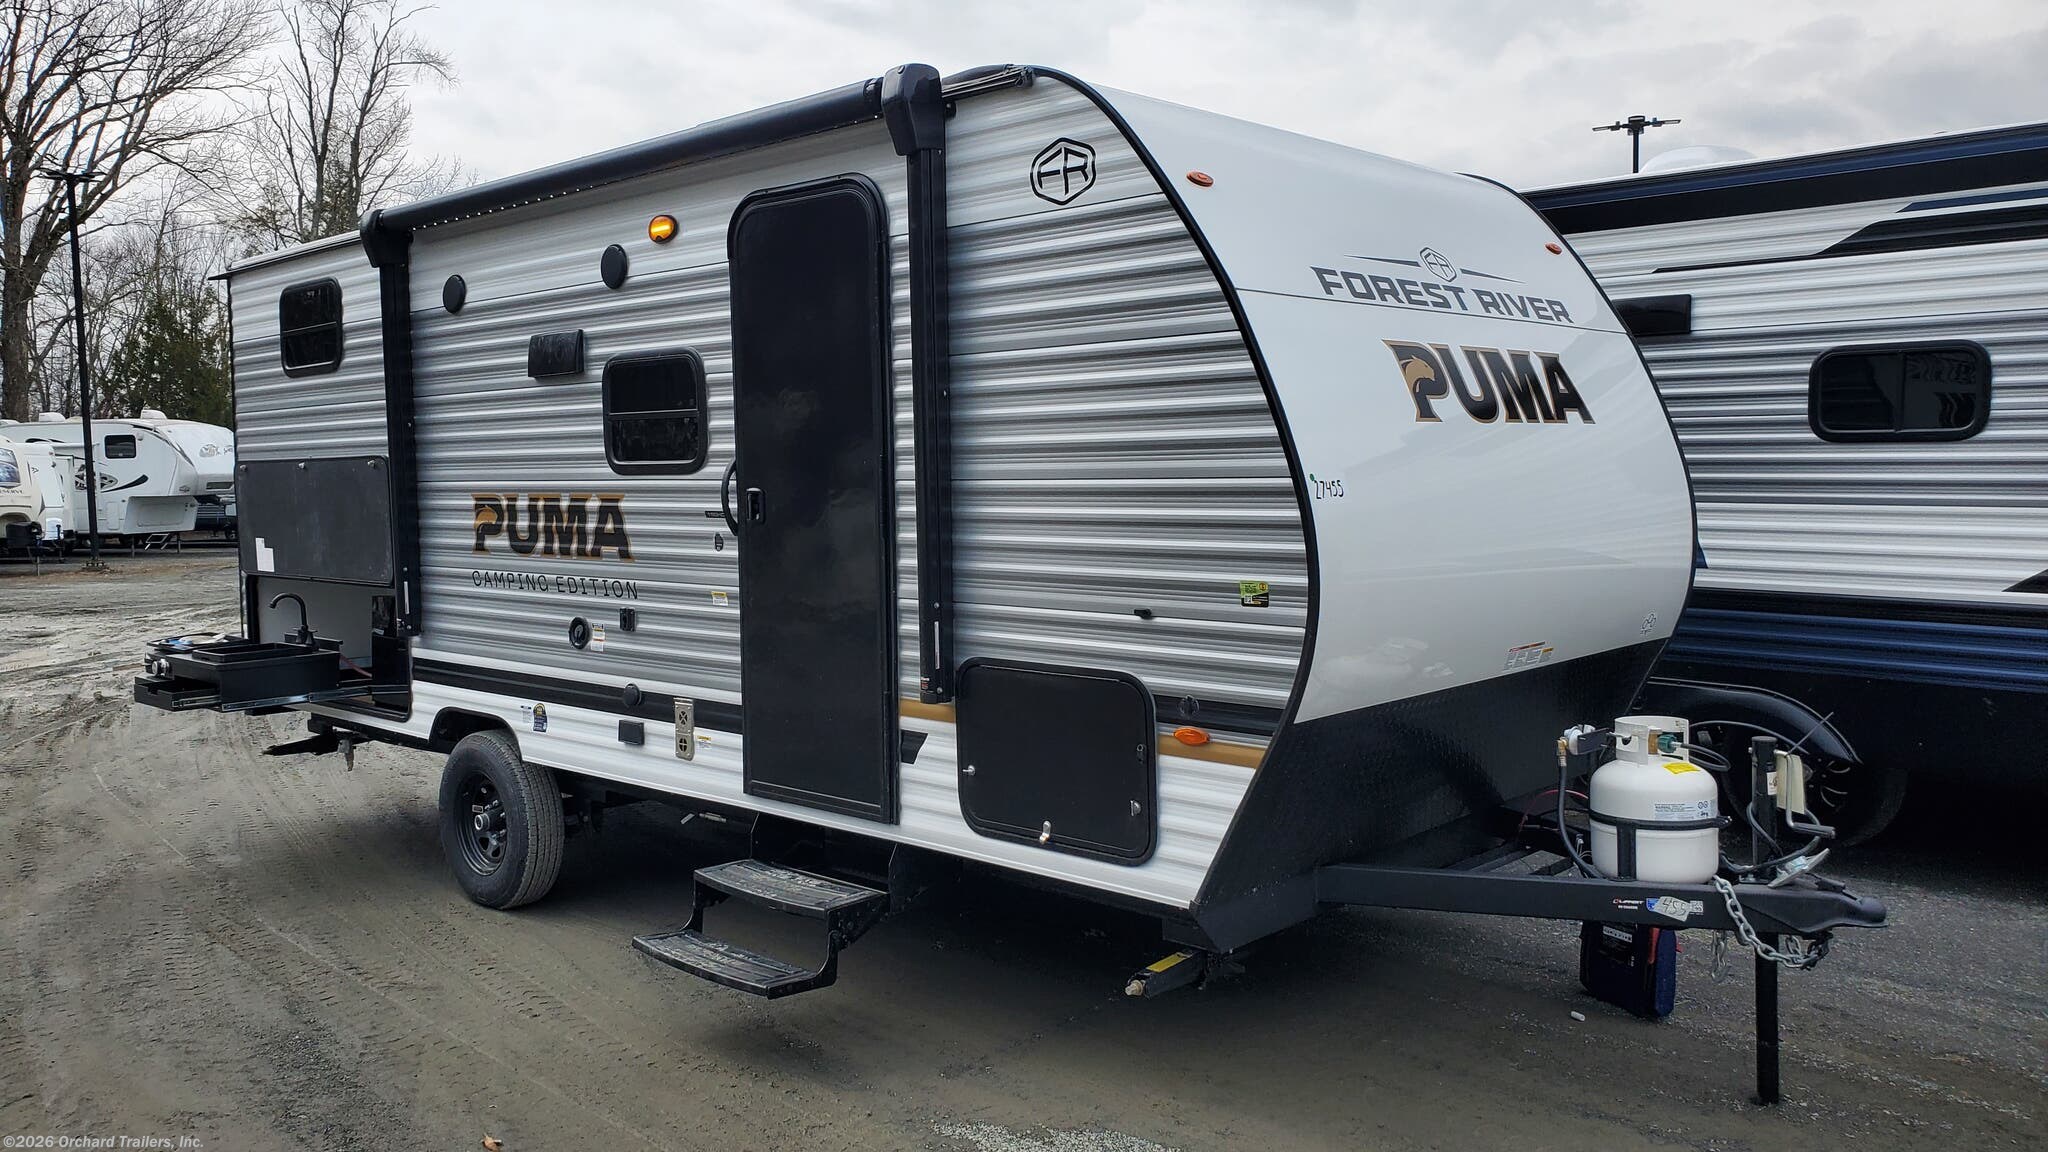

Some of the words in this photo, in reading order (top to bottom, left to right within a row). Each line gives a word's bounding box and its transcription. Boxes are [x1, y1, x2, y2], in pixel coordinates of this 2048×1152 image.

[1310, 266, 1468, 311] FOREST
[1471, 289, 1574, 324] RIVER
[1382, 340, 1596, 424] PUMA
[1313, 479, 1344, 499] 27455
[472, 493, 635, 562] PUMA
[472, 570, 549, 593] CAMPING
[556, 576, 639, 600] EDITION
[1662, 897, 1687, 917] 455
